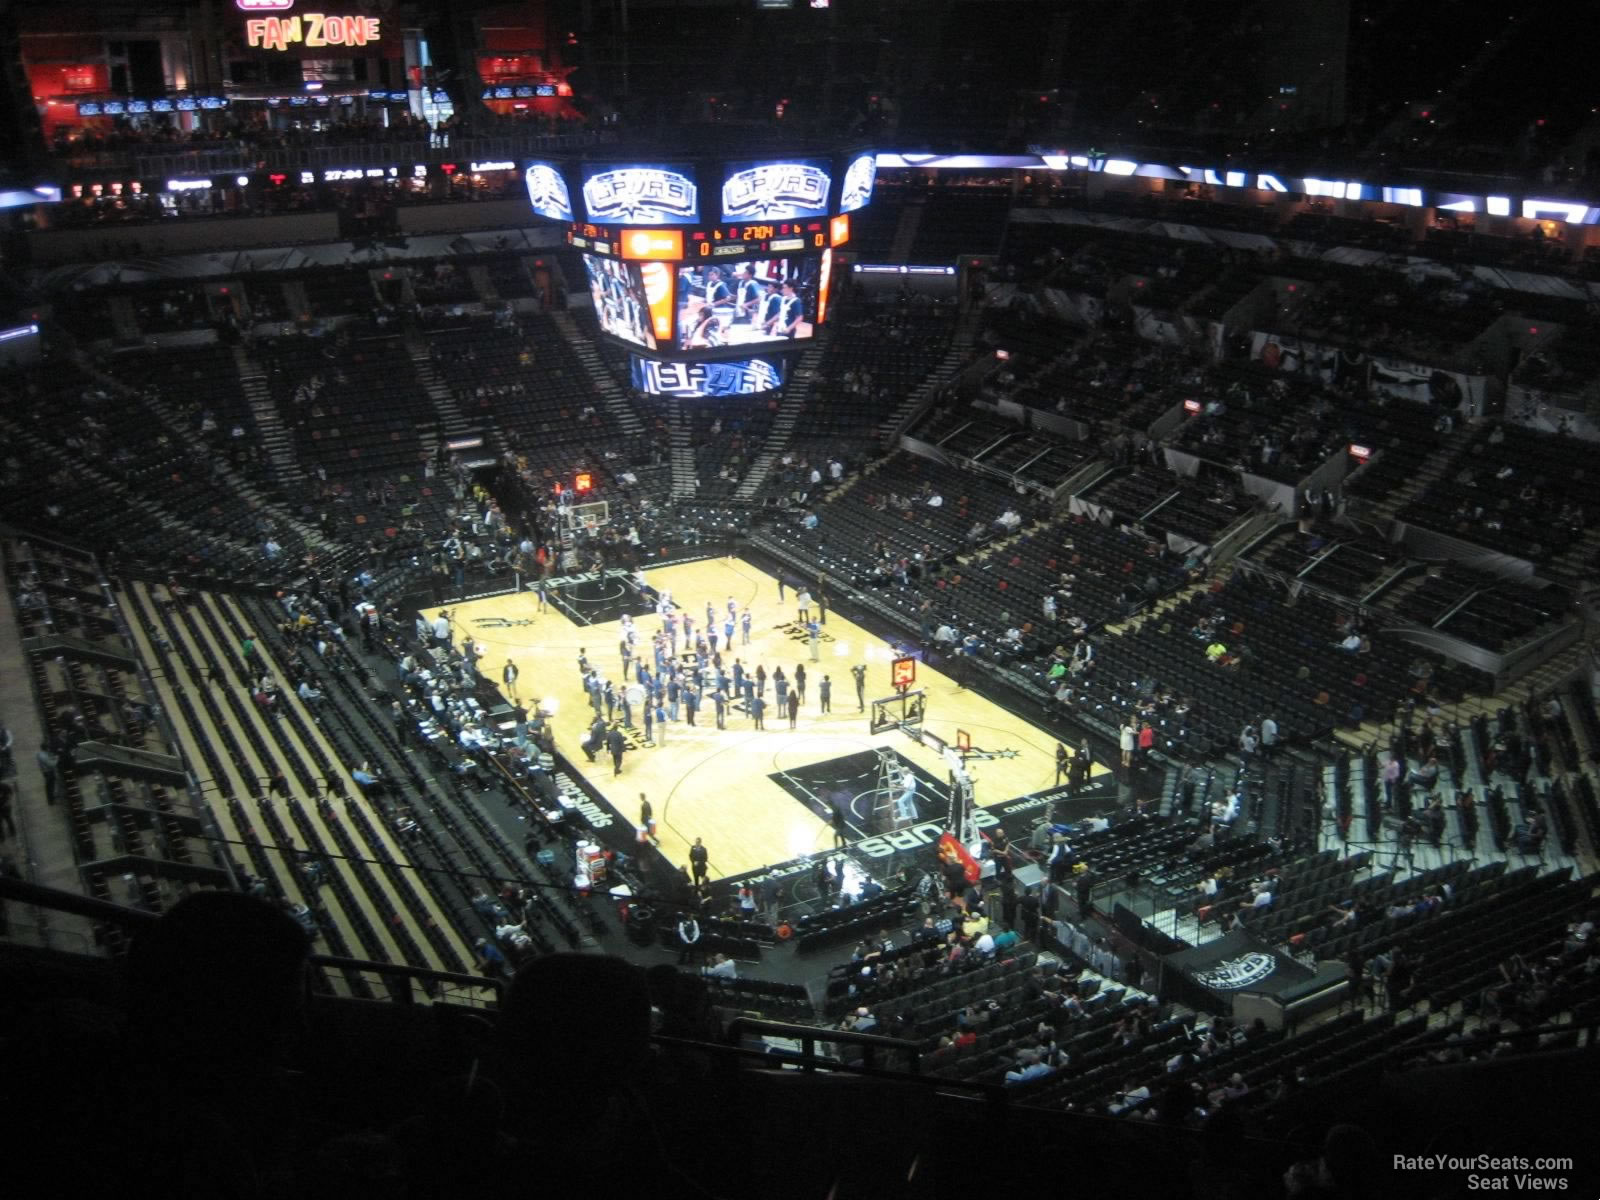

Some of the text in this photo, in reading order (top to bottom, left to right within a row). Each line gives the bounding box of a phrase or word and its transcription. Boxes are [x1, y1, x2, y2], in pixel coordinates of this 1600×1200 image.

[247, 13, 381, 51] FAN ZONE
[700, 242, 710, 256] 0
[815, 233, 824, 247] 0
[857, 809, 1000, 858] SURS
